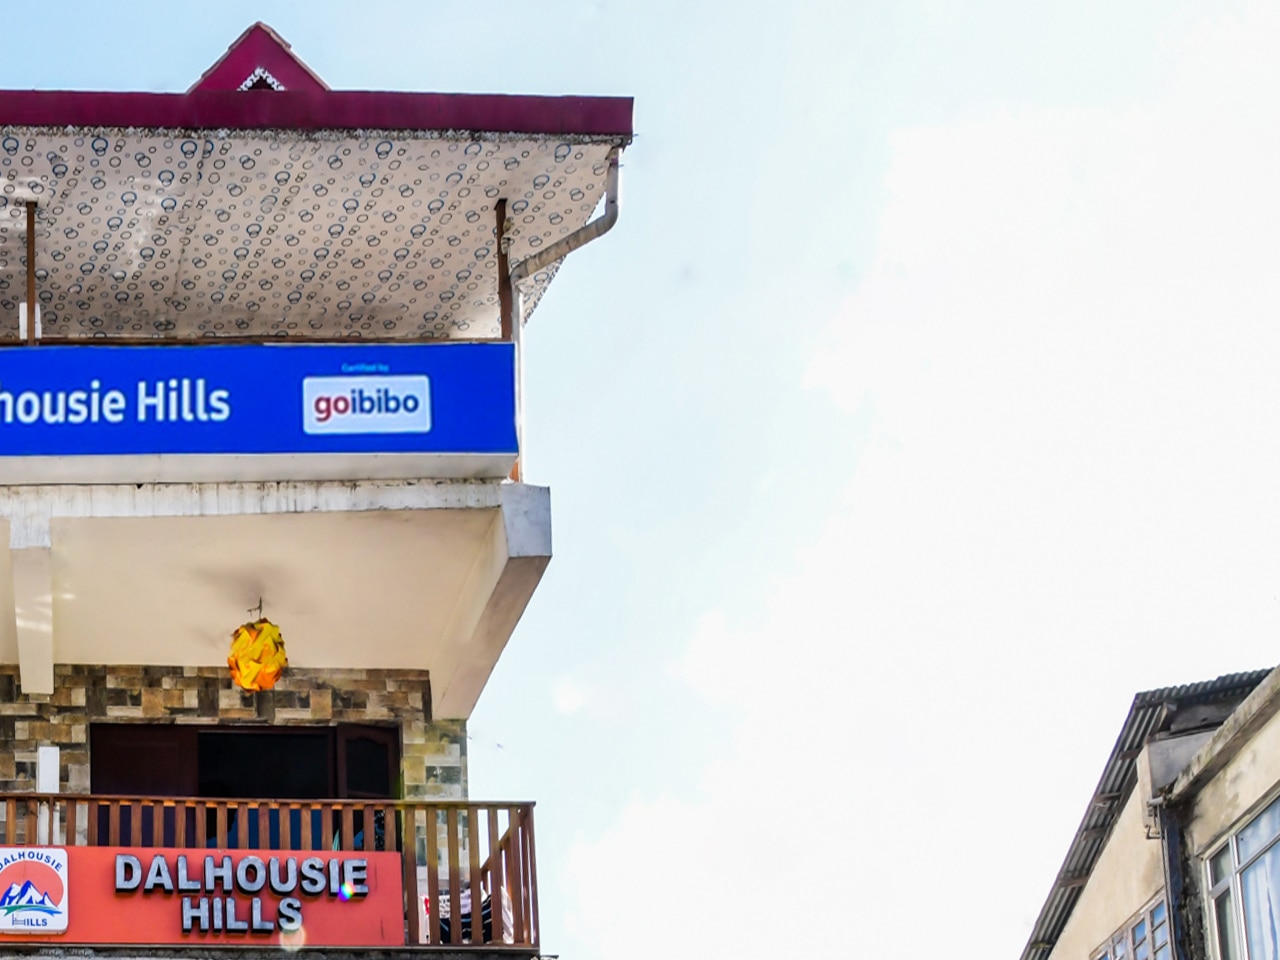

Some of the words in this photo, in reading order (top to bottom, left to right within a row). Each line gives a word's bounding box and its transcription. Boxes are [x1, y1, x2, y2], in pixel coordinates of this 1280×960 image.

[136, 378, 231, 422] Hills
[314, 388, 420, 423] goibibo
[115, 854, 369, 896] DALHOUSIE
[181, 896, 304, 934] HILLS
